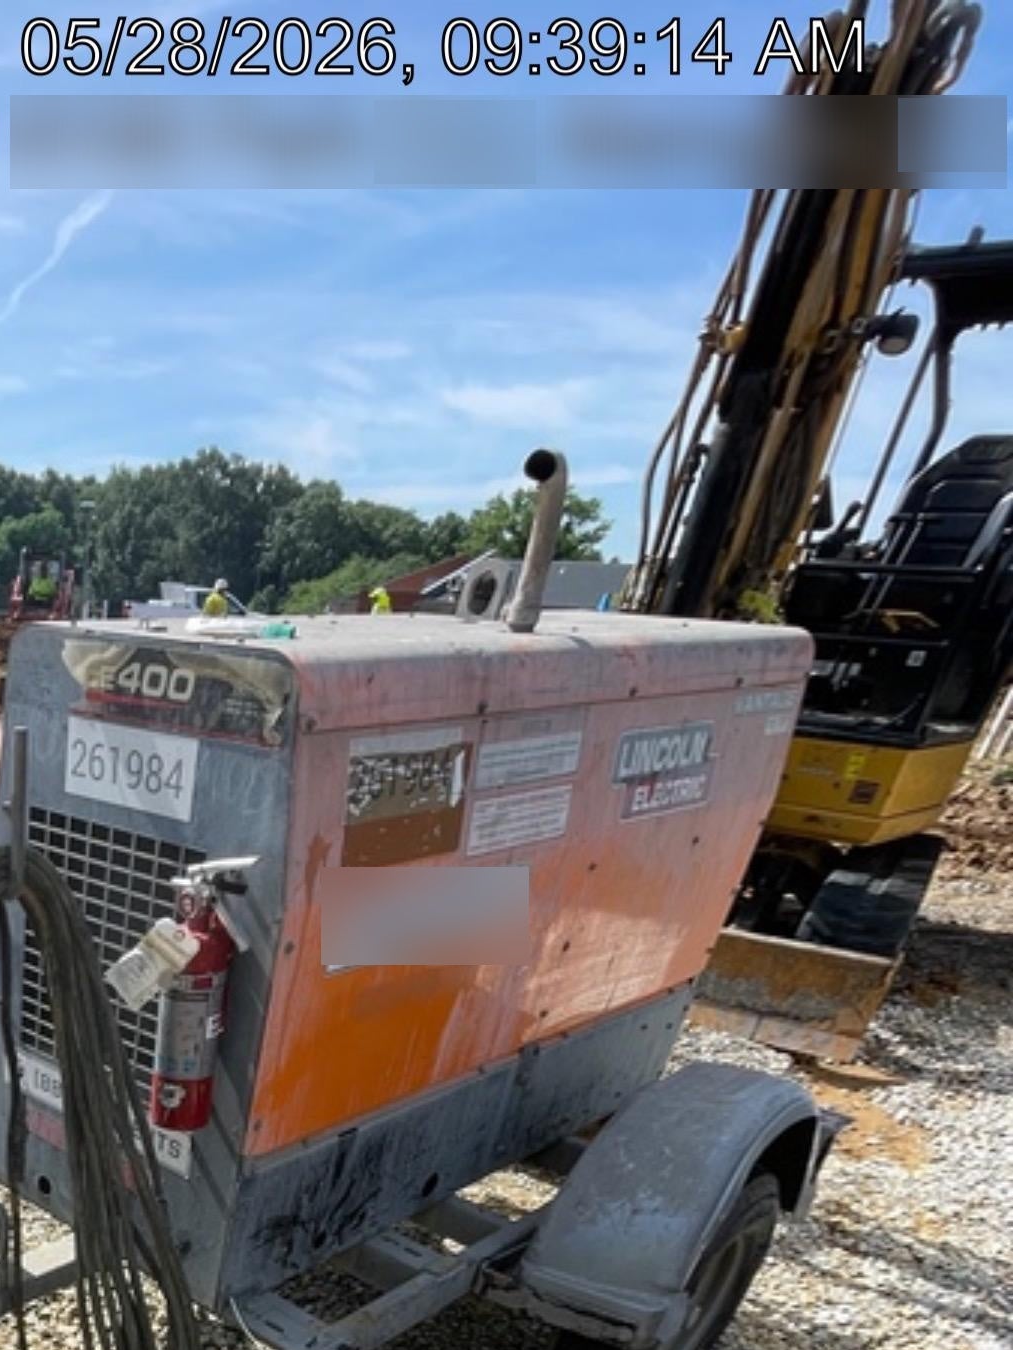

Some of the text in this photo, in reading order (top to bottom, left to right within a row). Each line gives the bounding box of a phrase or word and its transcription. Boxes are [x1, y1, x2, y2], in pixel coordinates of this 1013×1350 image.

[70, 738, 184, 800] 261984
[619, 732, 708, 777] LINCOLN
[632, 775, 705, 811] ELECTRIC
